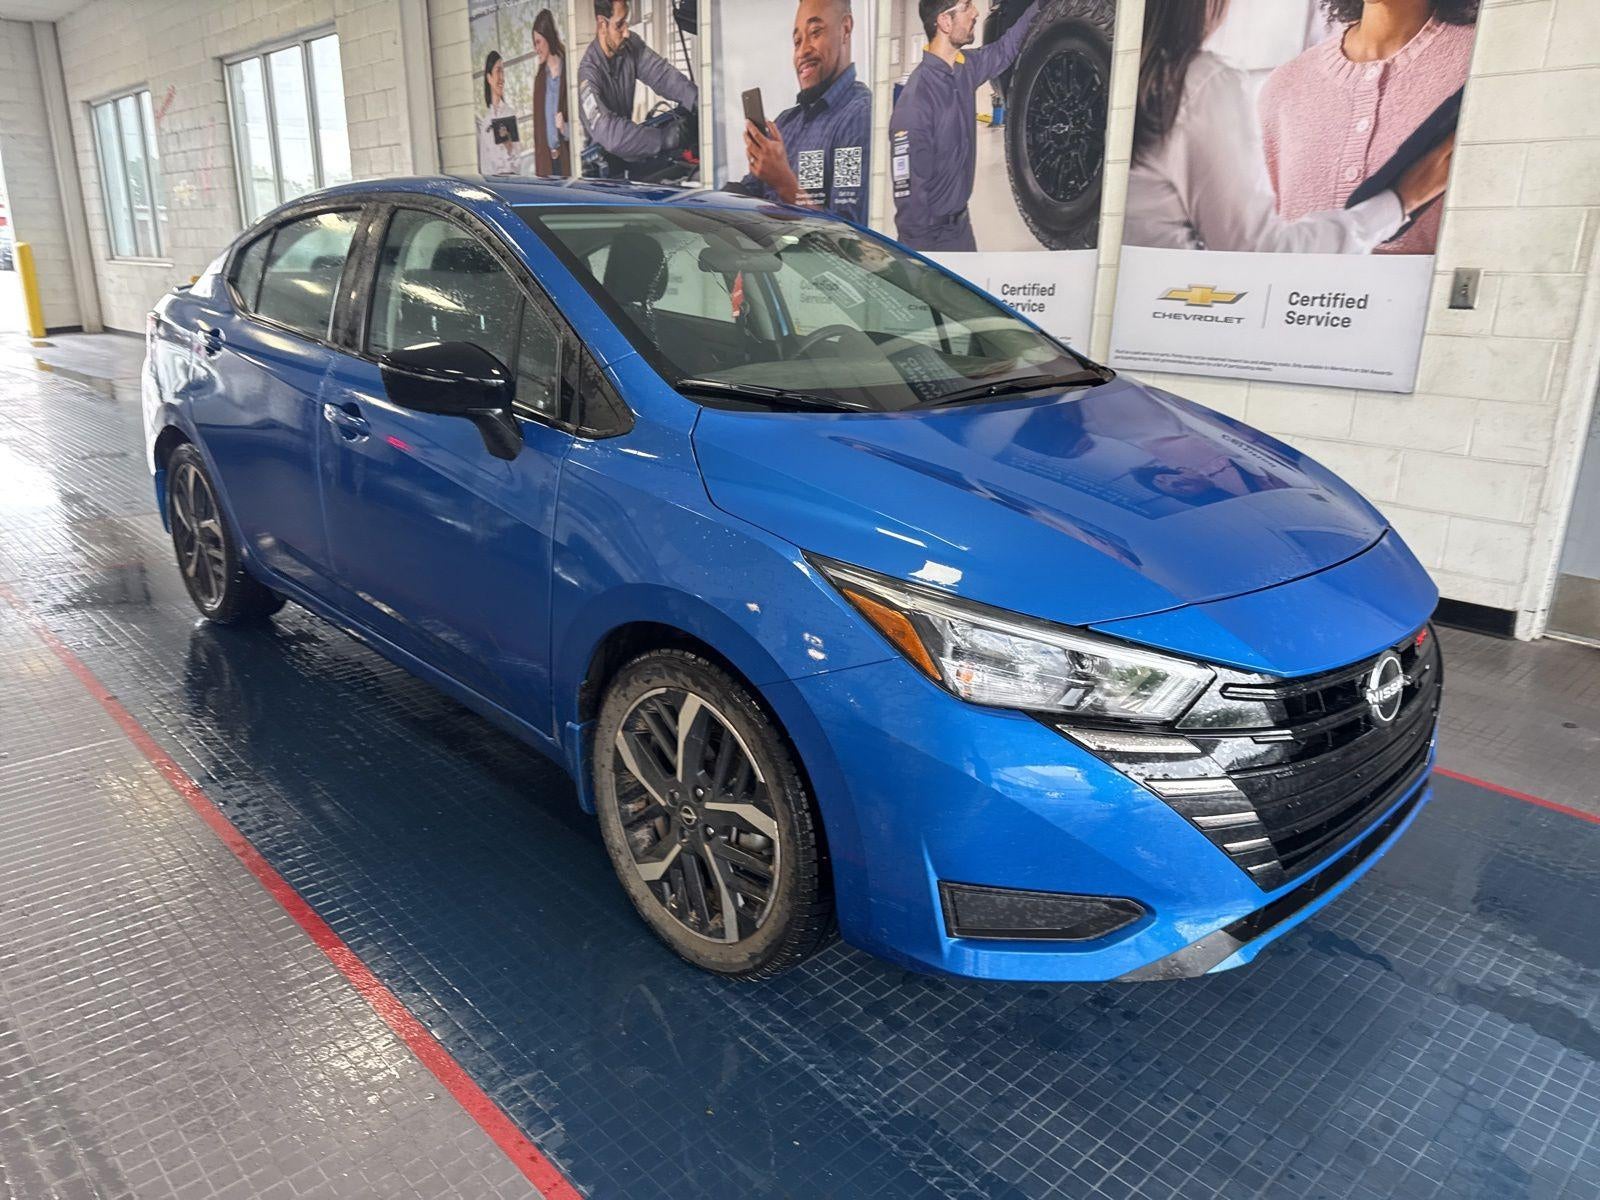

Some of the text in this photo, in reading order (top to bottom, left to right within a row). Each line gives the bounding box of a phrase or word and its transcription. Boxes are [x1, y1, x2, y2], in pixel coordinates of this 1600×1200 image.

[1001, 283, 1056, 297] Certified
[1002, 299, 1045, 312] ervice
[1288, 291, 1369, 310] Certified
[1152, 311, 1246, 325] CHEVROLET
[1285, 310, 1353, 328] Service
